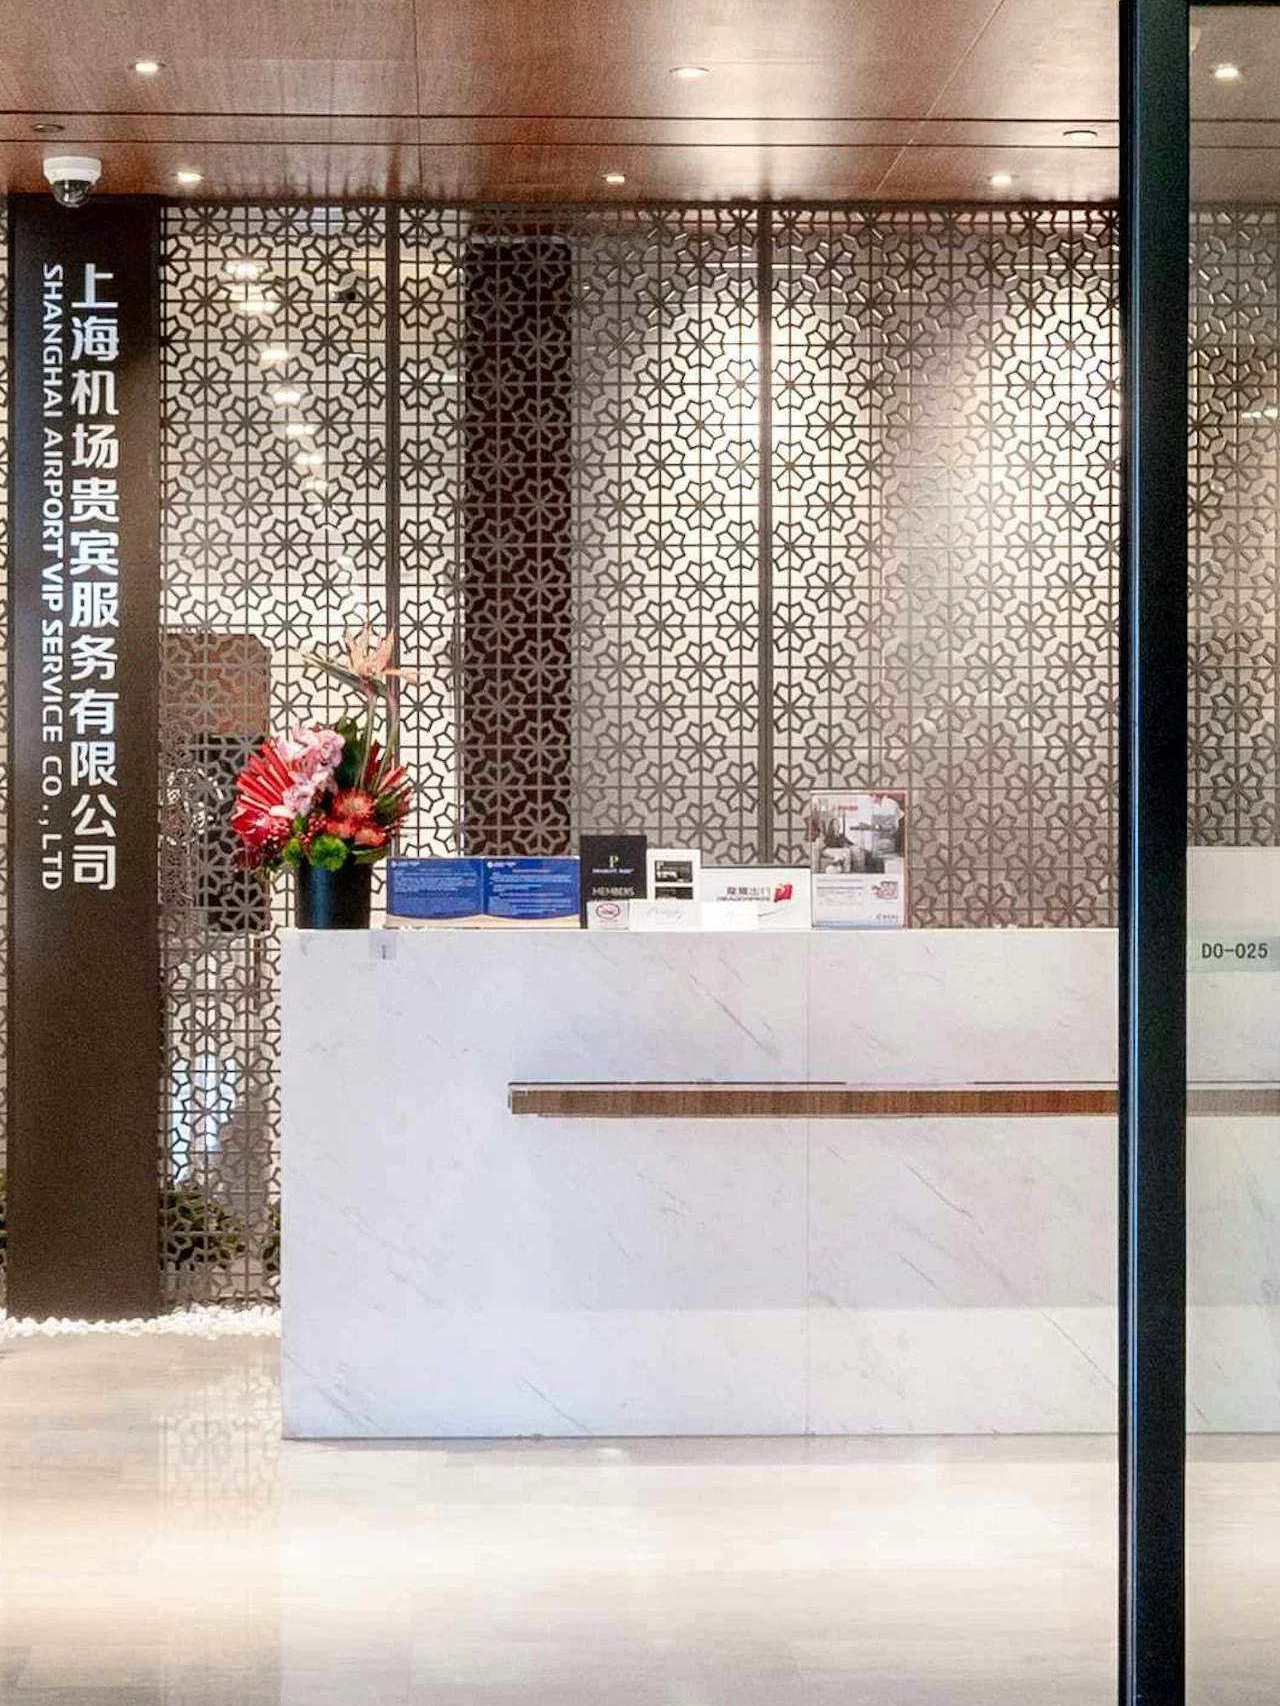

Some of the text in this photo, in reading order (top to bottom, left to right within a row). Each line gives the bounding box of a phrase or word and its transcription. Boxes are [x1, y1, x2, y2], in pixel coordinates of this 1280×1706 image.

[42, 264, 63, 417] SHANGHAI
[42, 427, 63, 558] AIRPORT
[42, 564, 63, 613] VIP
[70, 263, 120, 891] 上海机场贵宾服务有限公司
[41, 619, 63, 742] SERVICE
